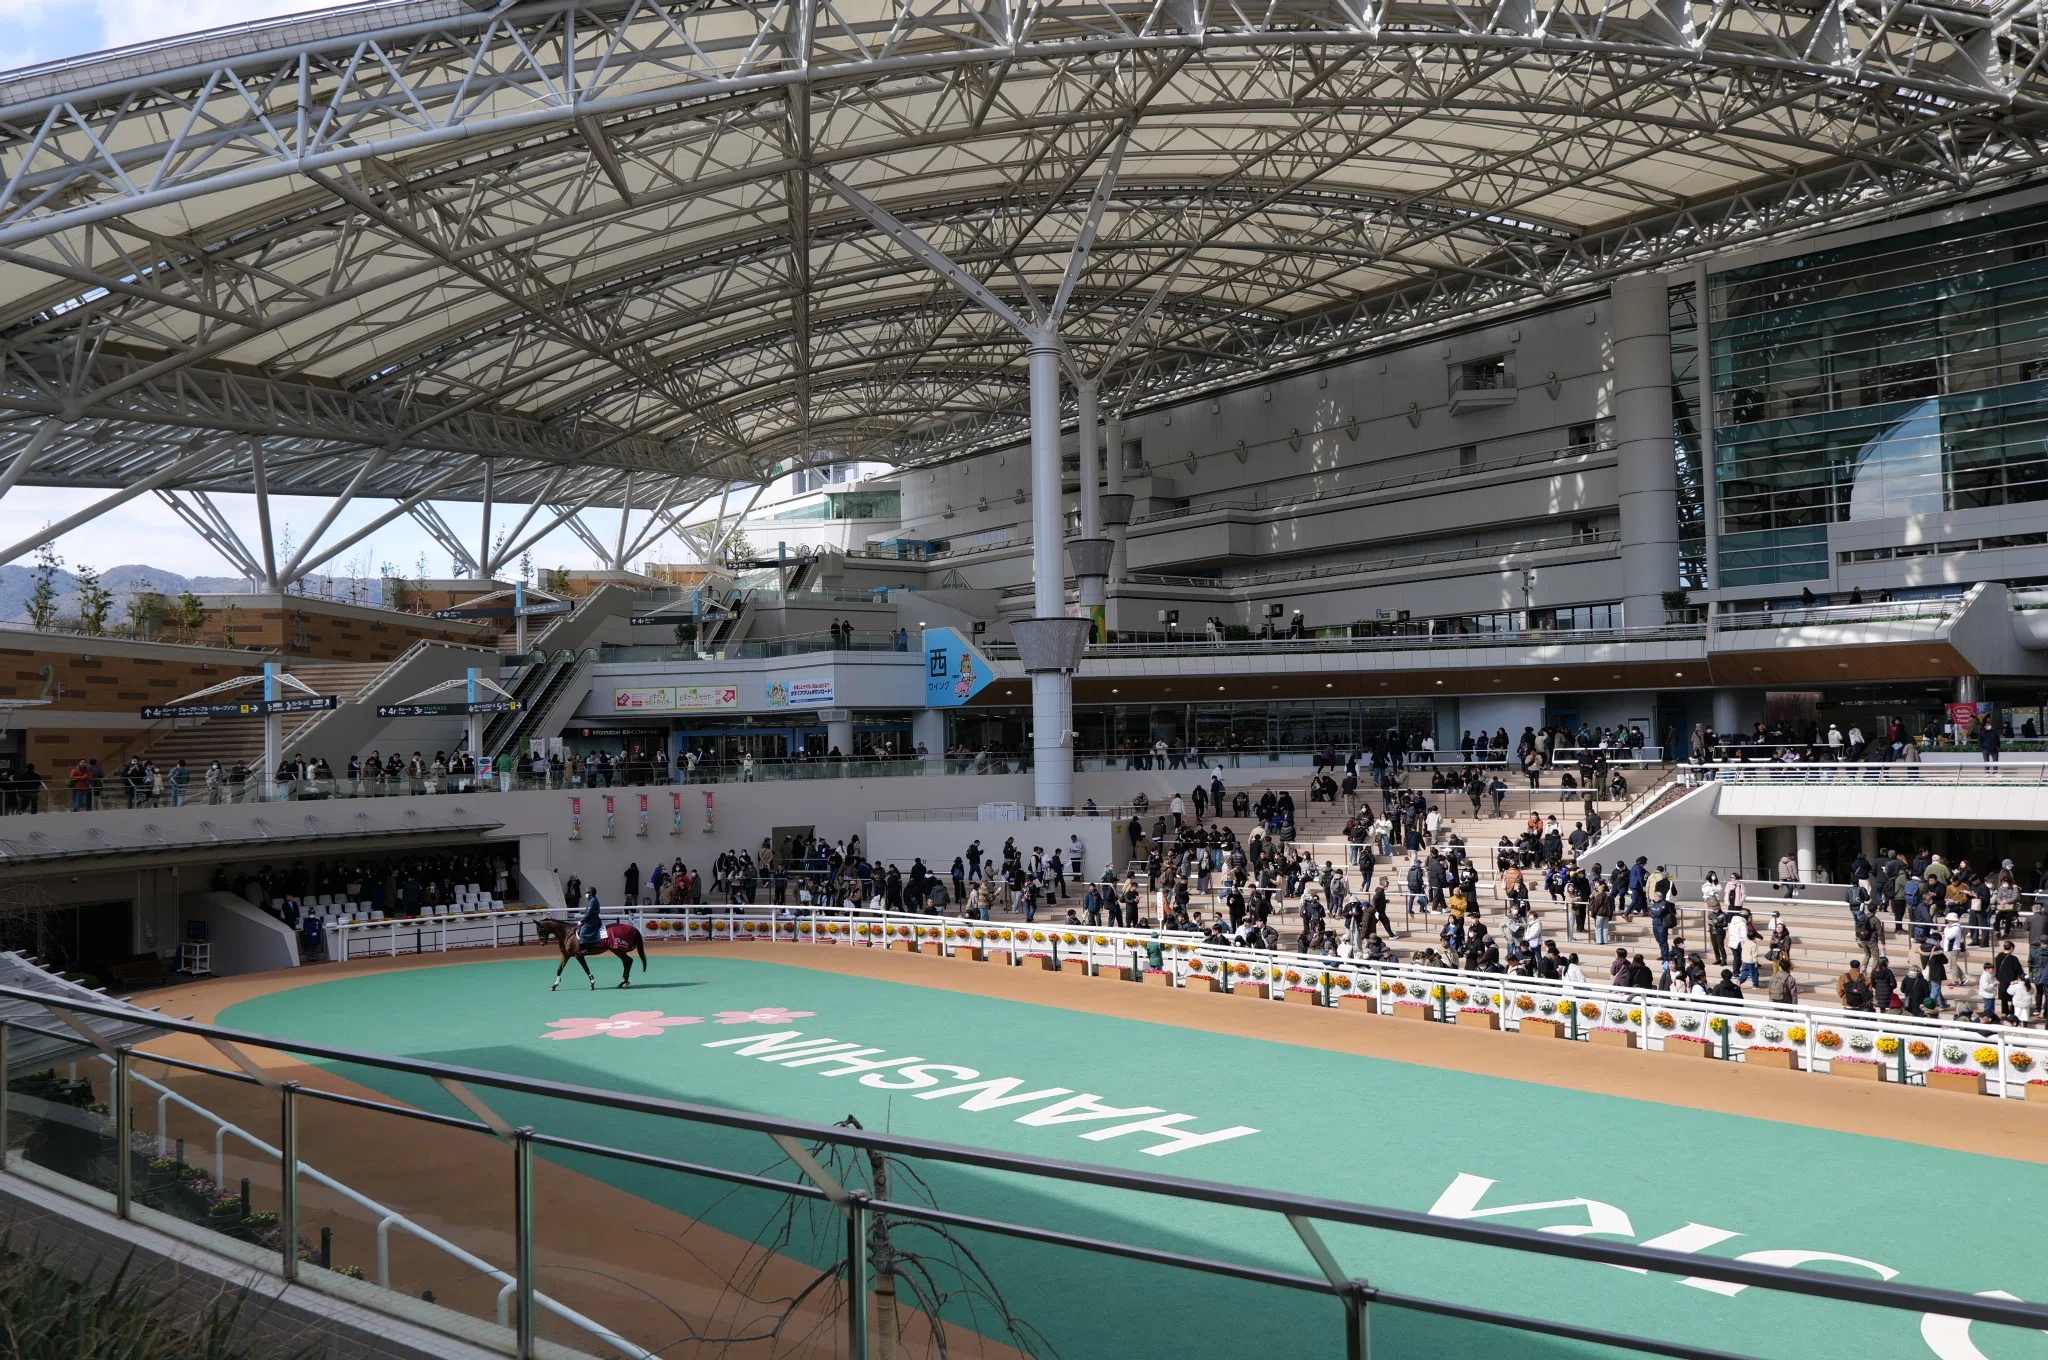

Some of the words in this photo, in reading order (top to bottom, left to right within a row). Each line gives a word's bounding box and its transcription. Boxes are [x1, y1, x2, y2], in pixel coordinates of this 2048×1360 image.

[929, 648, 947, 678] 西
[39, 661, 66, 702] 2F
[388, 707, 397, 715] 4F
[414, 706, 423, 715] 3F
[701, 1030, 1262, 1157] HANSHIN
